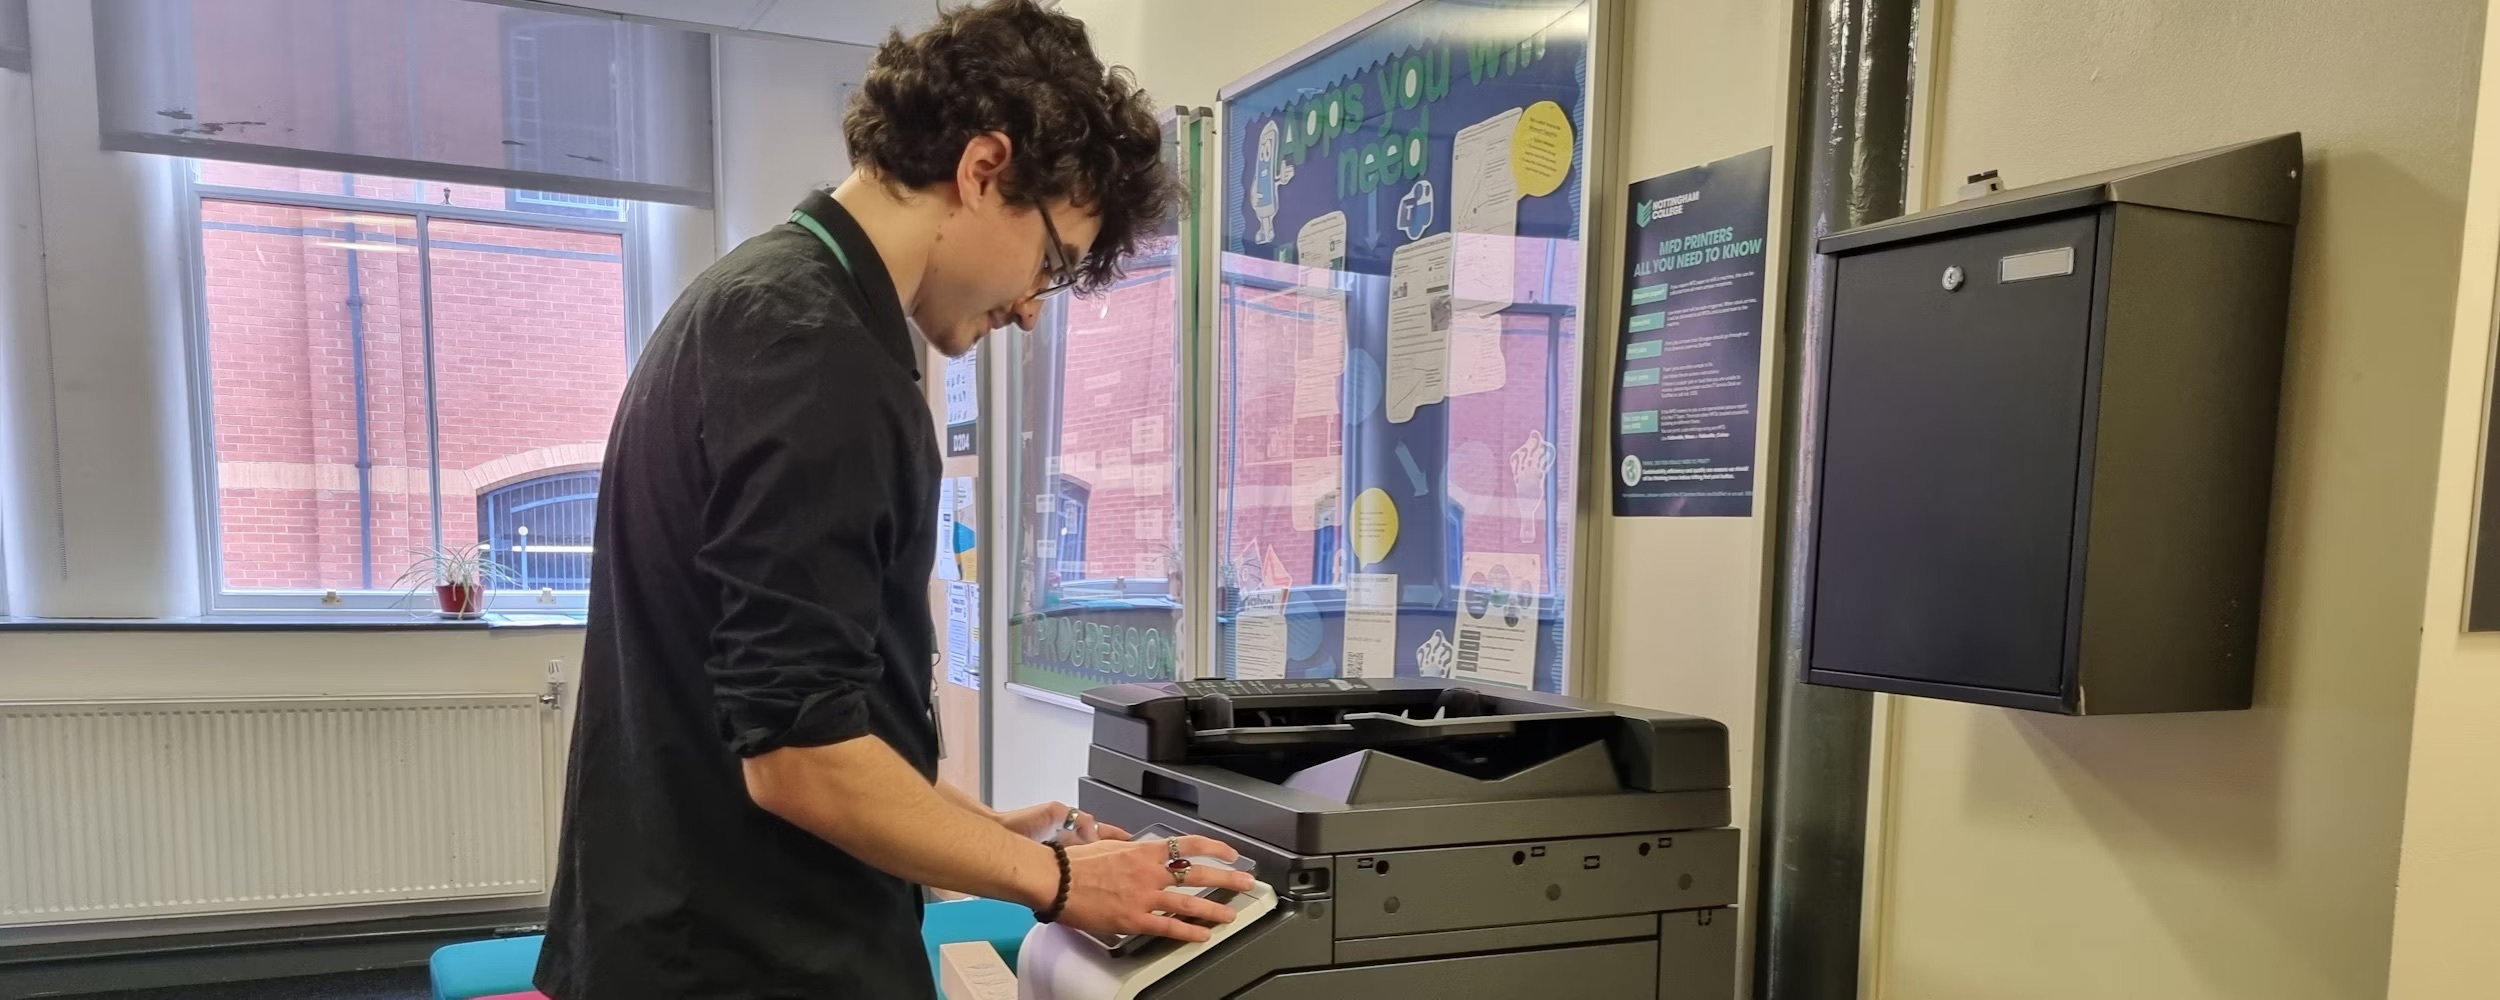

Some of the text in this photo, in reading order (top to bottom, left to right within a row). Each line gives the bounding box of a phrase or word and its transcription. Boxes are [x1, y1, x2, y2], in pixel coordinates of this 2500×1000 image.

[1278, 82, 1364, 167] Apps
[1377, 41, 1450, 137] you
[1336, 105, 1430, 200] need
[1651, 205, 1684, 220] COLLEGE
[1652, 191, 1700, 211] NOTTINGHAM
[1633, 238, 1763, 277] ALL YOU NEED TO KNOW
[1659, 227, 1734, 256] MFD PRINTERS
[953, 433, 970, 452] D204
[1034, 612, 1177, 680] PROGRESSION
